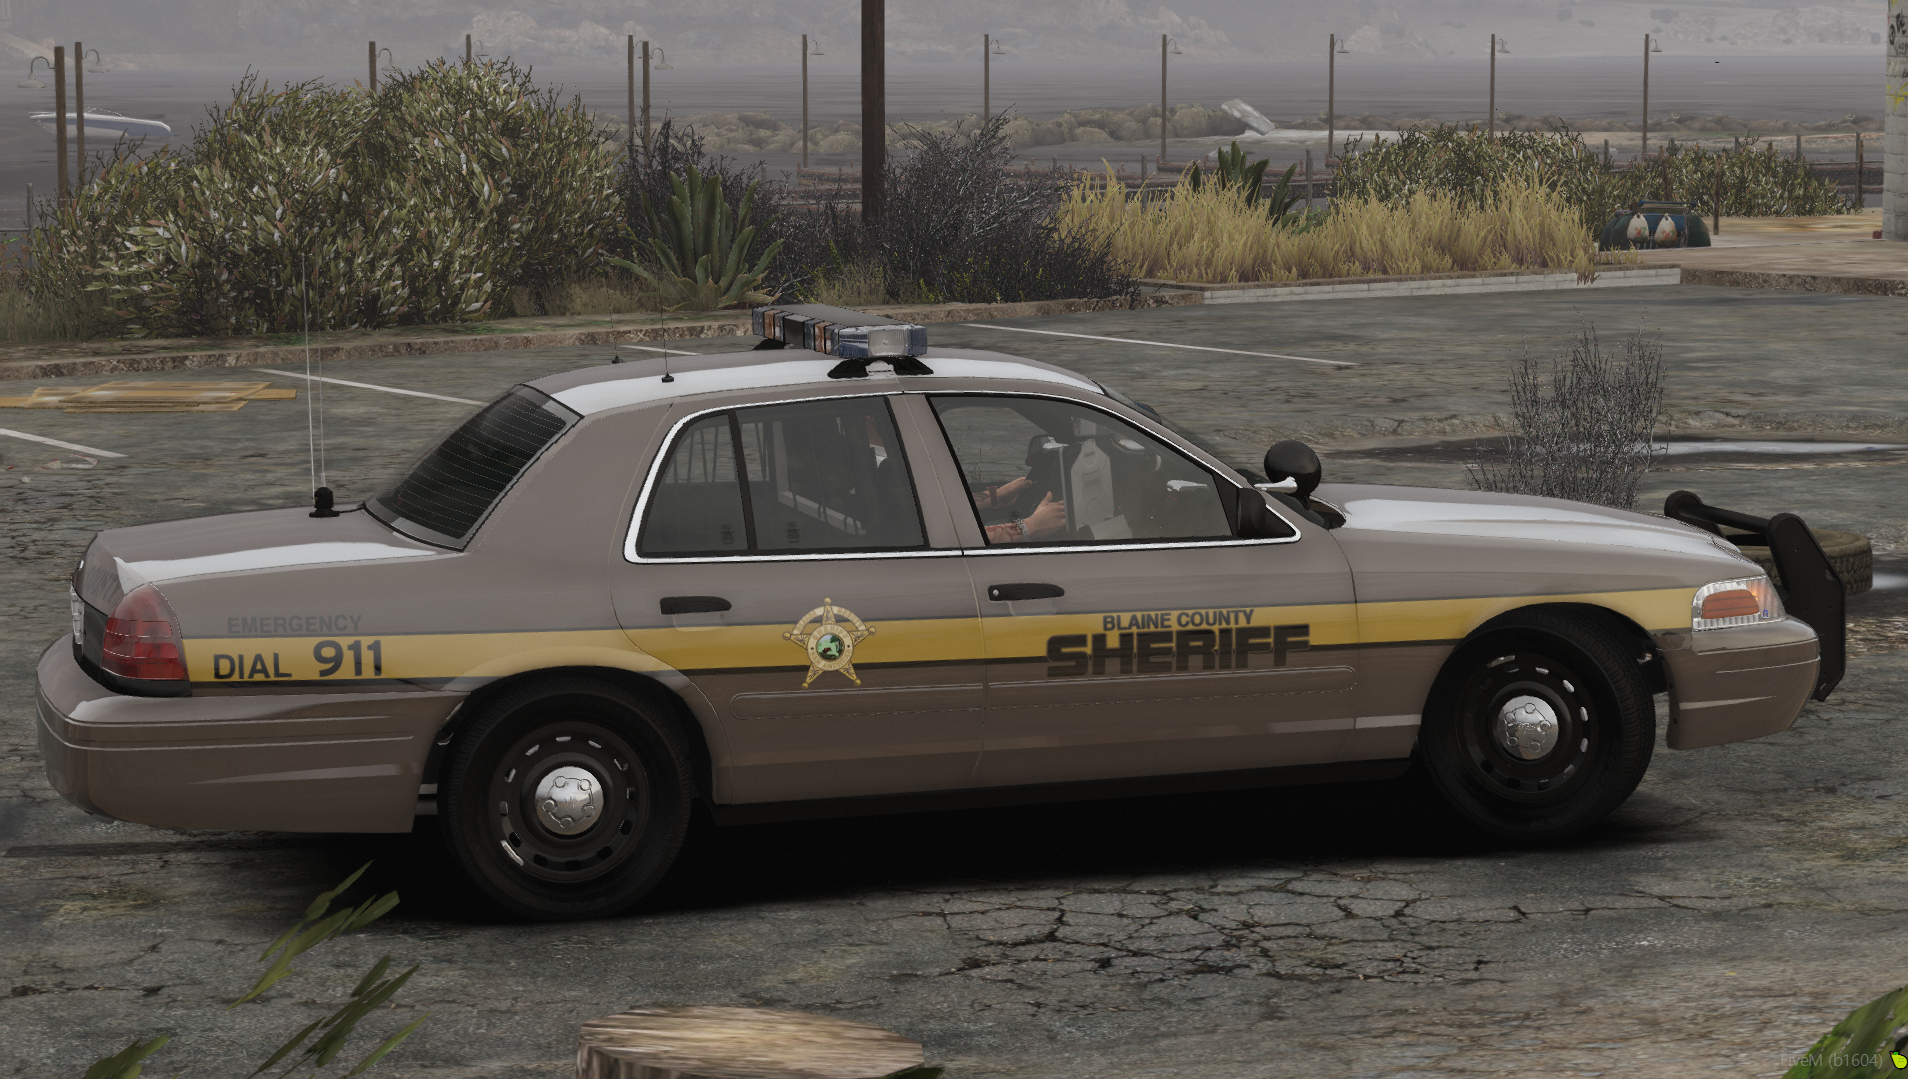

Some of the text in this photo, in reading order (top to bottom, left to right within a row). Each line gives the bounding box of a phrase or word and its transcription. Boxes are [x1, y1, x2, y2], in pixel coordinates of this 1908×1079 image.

[227, 614, 362, 634] EMERGENCY
[1103, 609, 1255, 632] BLAINE COUNTY
[213, 640, 382, 680] DIAL 911
[1046, 624, 1310, 678] SHERIFF
